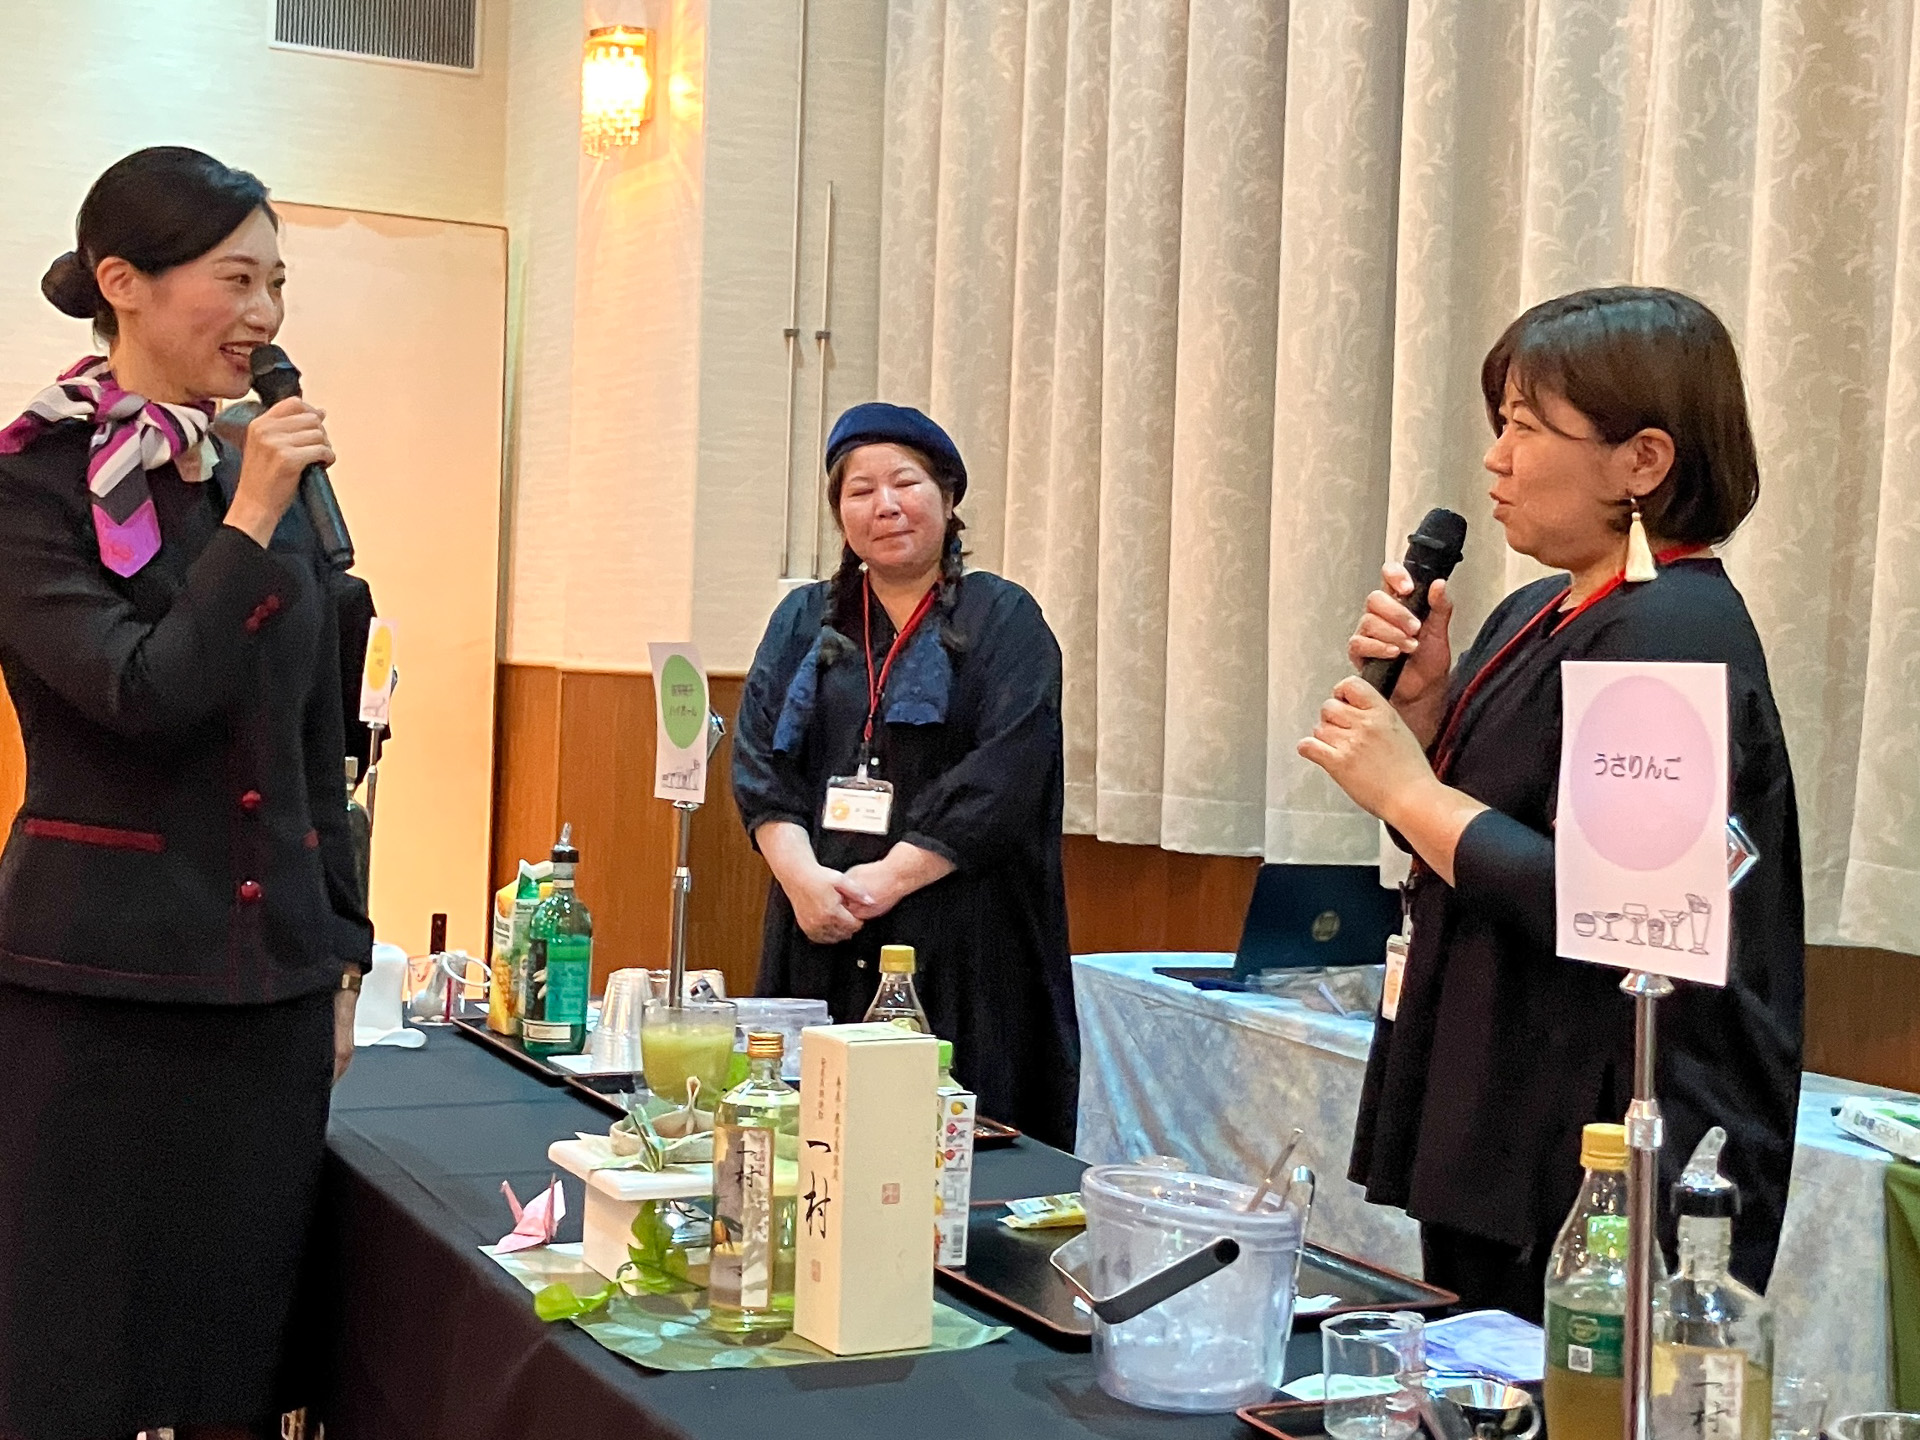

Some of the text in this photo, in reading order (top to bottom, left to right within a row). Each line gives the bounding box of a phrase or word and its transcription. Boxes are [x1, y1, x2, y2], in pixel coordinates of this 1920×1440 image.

[1593, 753, 1682, 781] うさりんご
[803, 1139, 832, 1239] 一村
